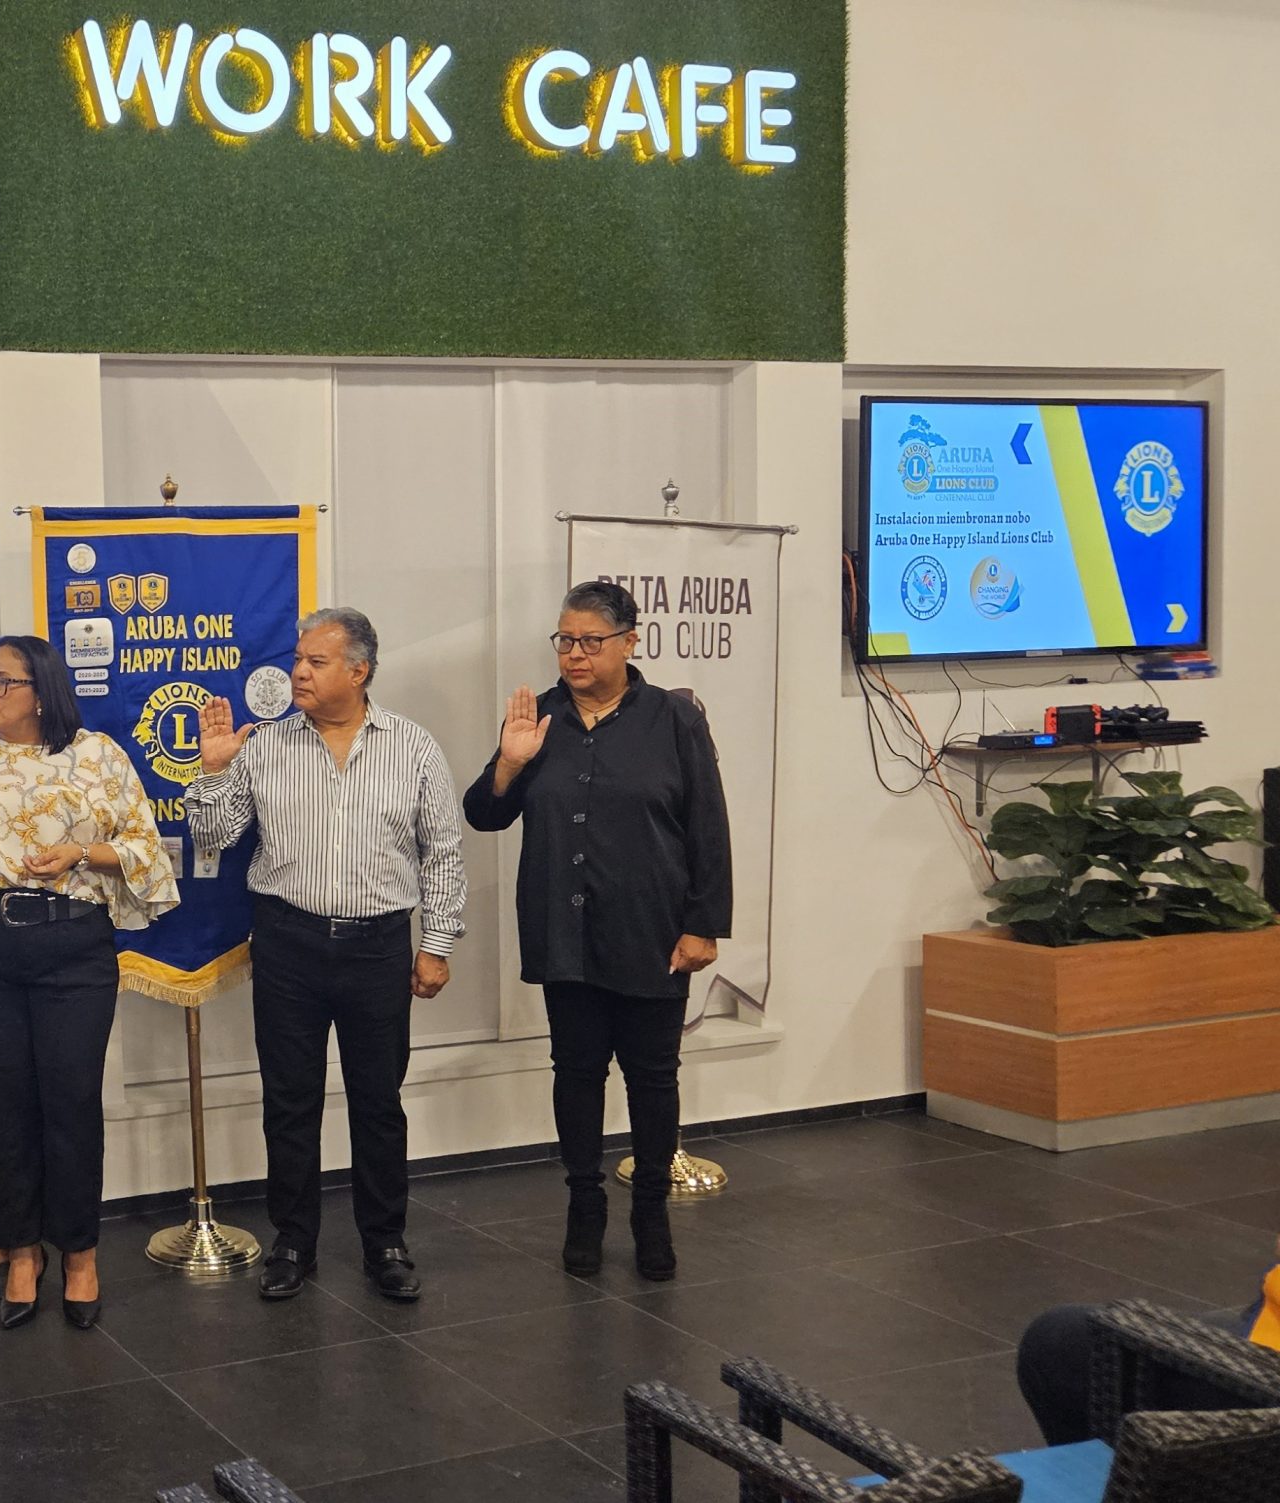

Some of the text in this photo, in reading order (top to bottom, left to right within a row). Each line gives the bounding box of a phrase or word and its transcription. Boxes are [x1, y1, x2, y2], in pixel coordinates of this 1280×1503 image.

[79, 19, 797, 164] WORK CAFE
[906, 444, 928, 456] LIONS
[937, 447, 994, 463] ARUBA
[1130, 444, 1170, 464] LIONS
[936, 478, 966, 490] LIONS
[968, 478, 995, 490] CLUB
[1141, 470, 1160, 503] L
[875, 511, 1031, 525] Instalacion miembronan nobo
[875, 530, 1054, 549] Aruba One Happy Island Lions Club
[597, 575, 753, 615] LTA ARUBA
[977, 586, 1009, 594] CHANGING
[126, 614, 233, 641] ARUBA ONE
[630, 620, 732, 660] EO CLUB
[119, 646, 241, 673] HAPPY ISLAND
[249, 668, 288, 688] LEO CLUB
[153, 684, 210, 706] LIONS
[251, 698, 288, 716] SPONSOR
[172, 713, 198, 750] L
[156, 761, 202, 779] INTERNATIO
